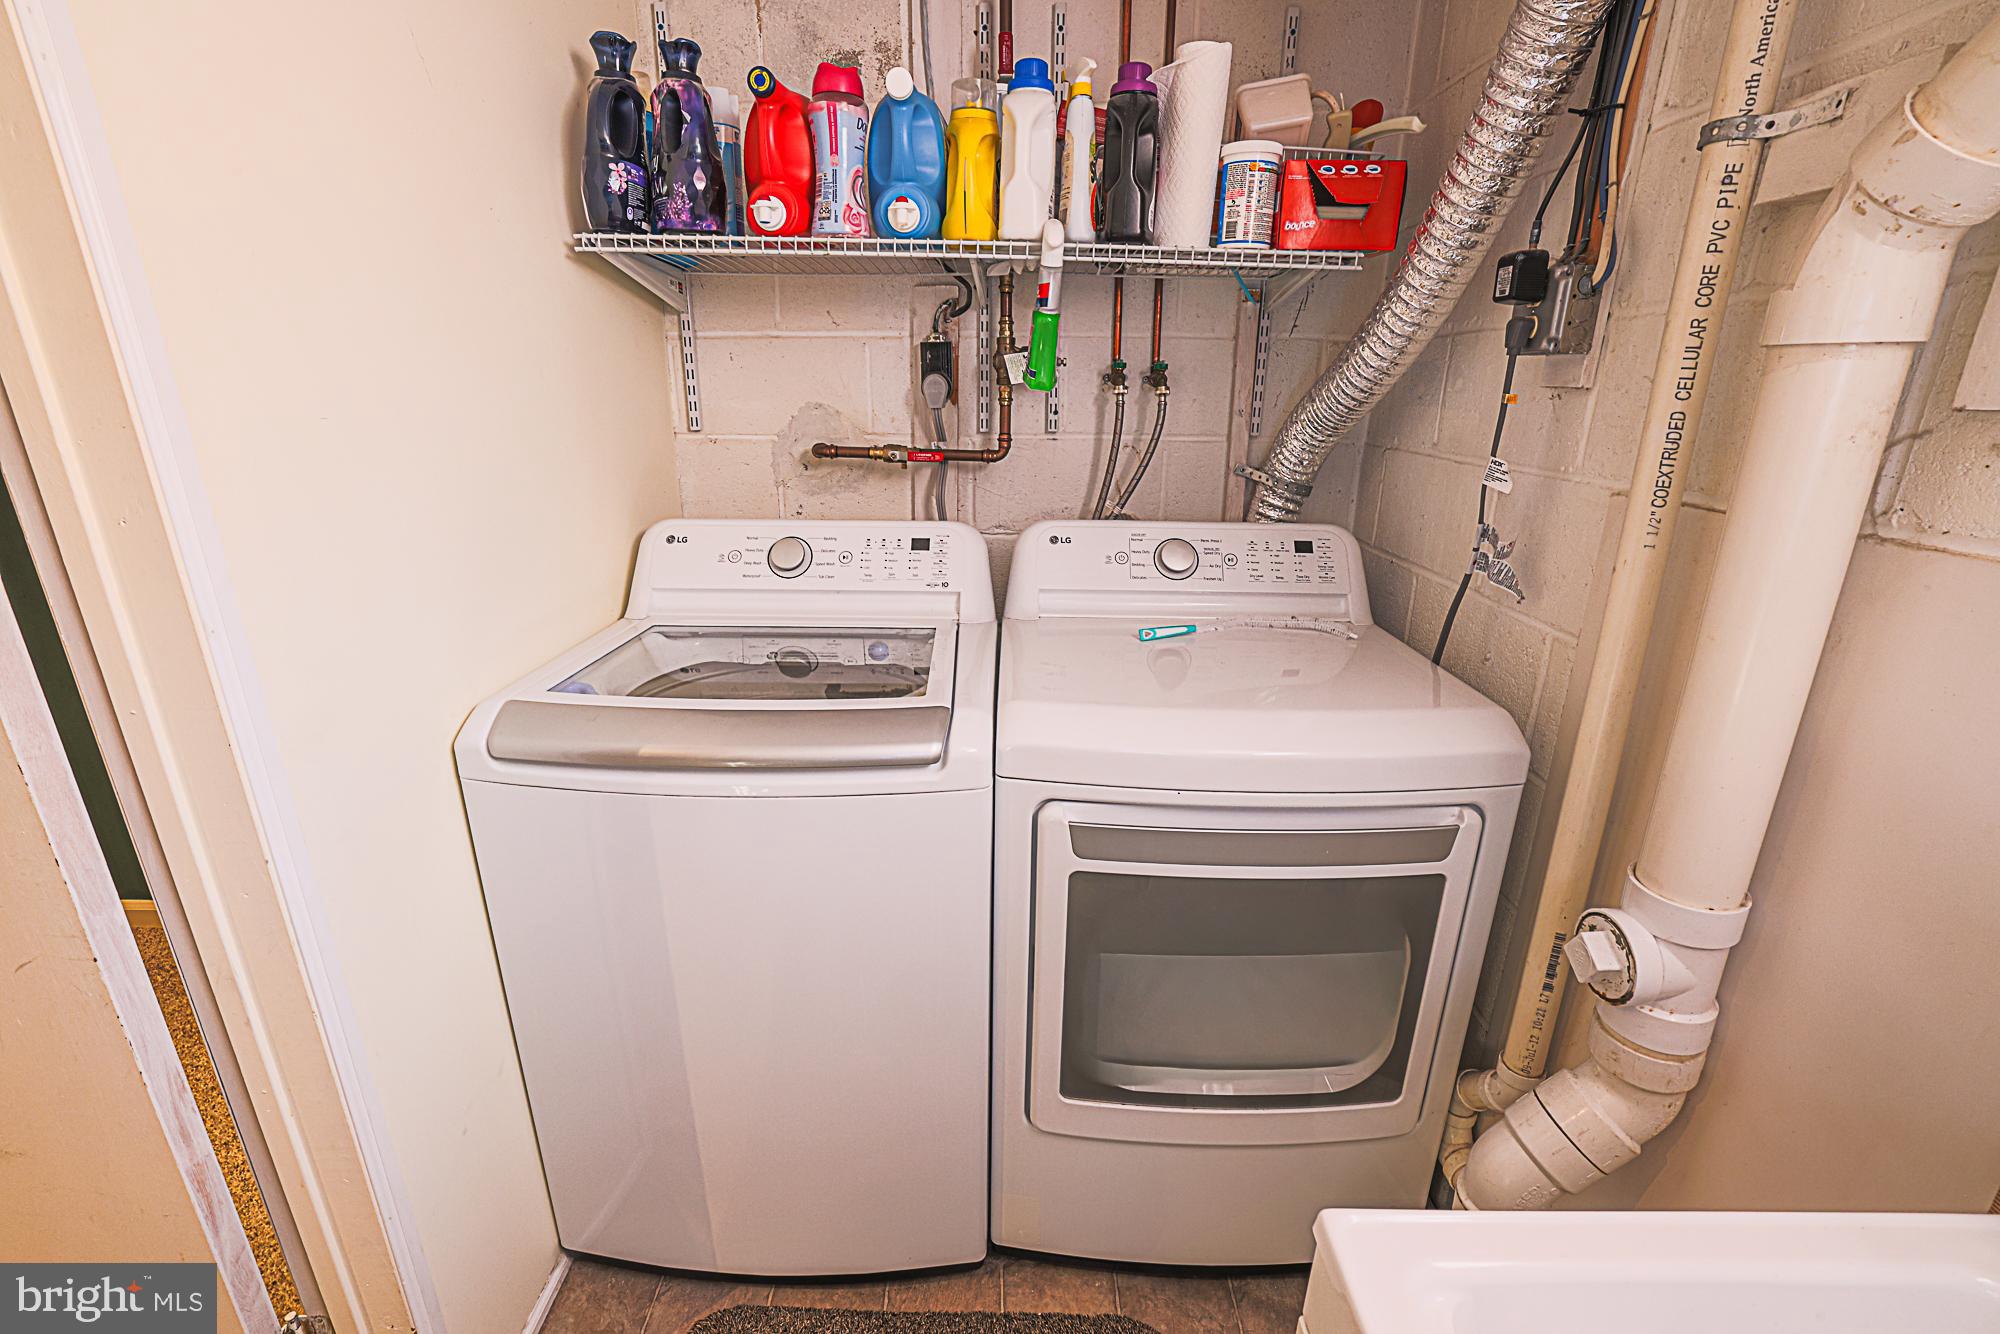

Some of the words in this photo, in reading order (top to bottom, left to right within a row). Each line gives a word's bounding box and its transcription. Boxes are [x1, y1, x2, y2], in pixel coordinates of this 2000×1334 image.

[1739, 72, 1762, 117] North
[1716, 162, 1744, 209] PIPE
[1706, 219, 1730, 254] PVC
[1694, 264, 1721, 308] CORE
[1674, 317, 1709, 401] CELLULAR
[1651, 411, 1687, 509] COEXTRUDED
[676, 536, 688, 544] LG
[1060, 536, 1072, 544] LG
[1532, 1008, 1547, 1031] 10:21
